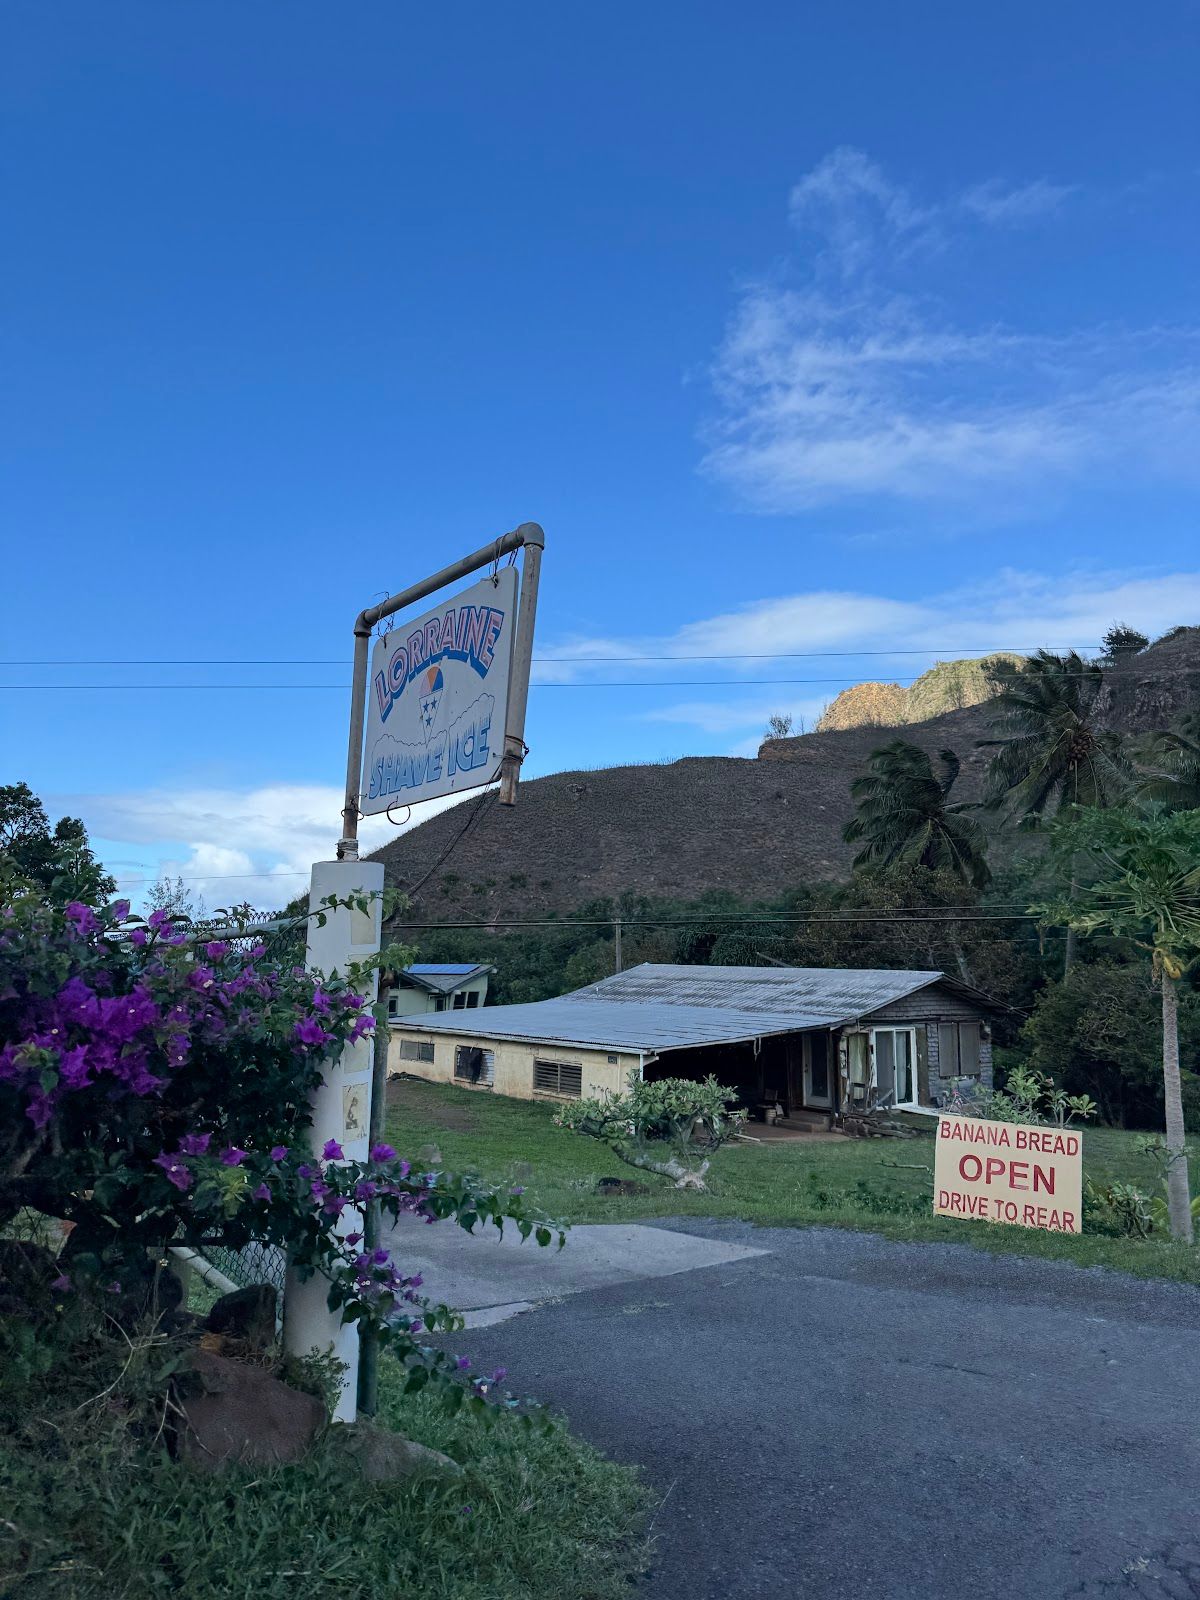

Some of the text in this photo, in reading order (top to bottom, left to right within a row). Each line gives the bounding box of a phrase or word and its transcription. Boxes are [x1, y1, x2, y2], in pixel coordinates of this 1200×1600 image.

[374, 606, 505, 723] LORRAINE
[369, 718, 491, 799] SHAVE ICE
[940, 1120, 1079, 1156] BANANA BREAD
[958, 1154, 1055, 1195] OPEN
[939, 1190, 1075, 1232] DRIVE TO REAR
